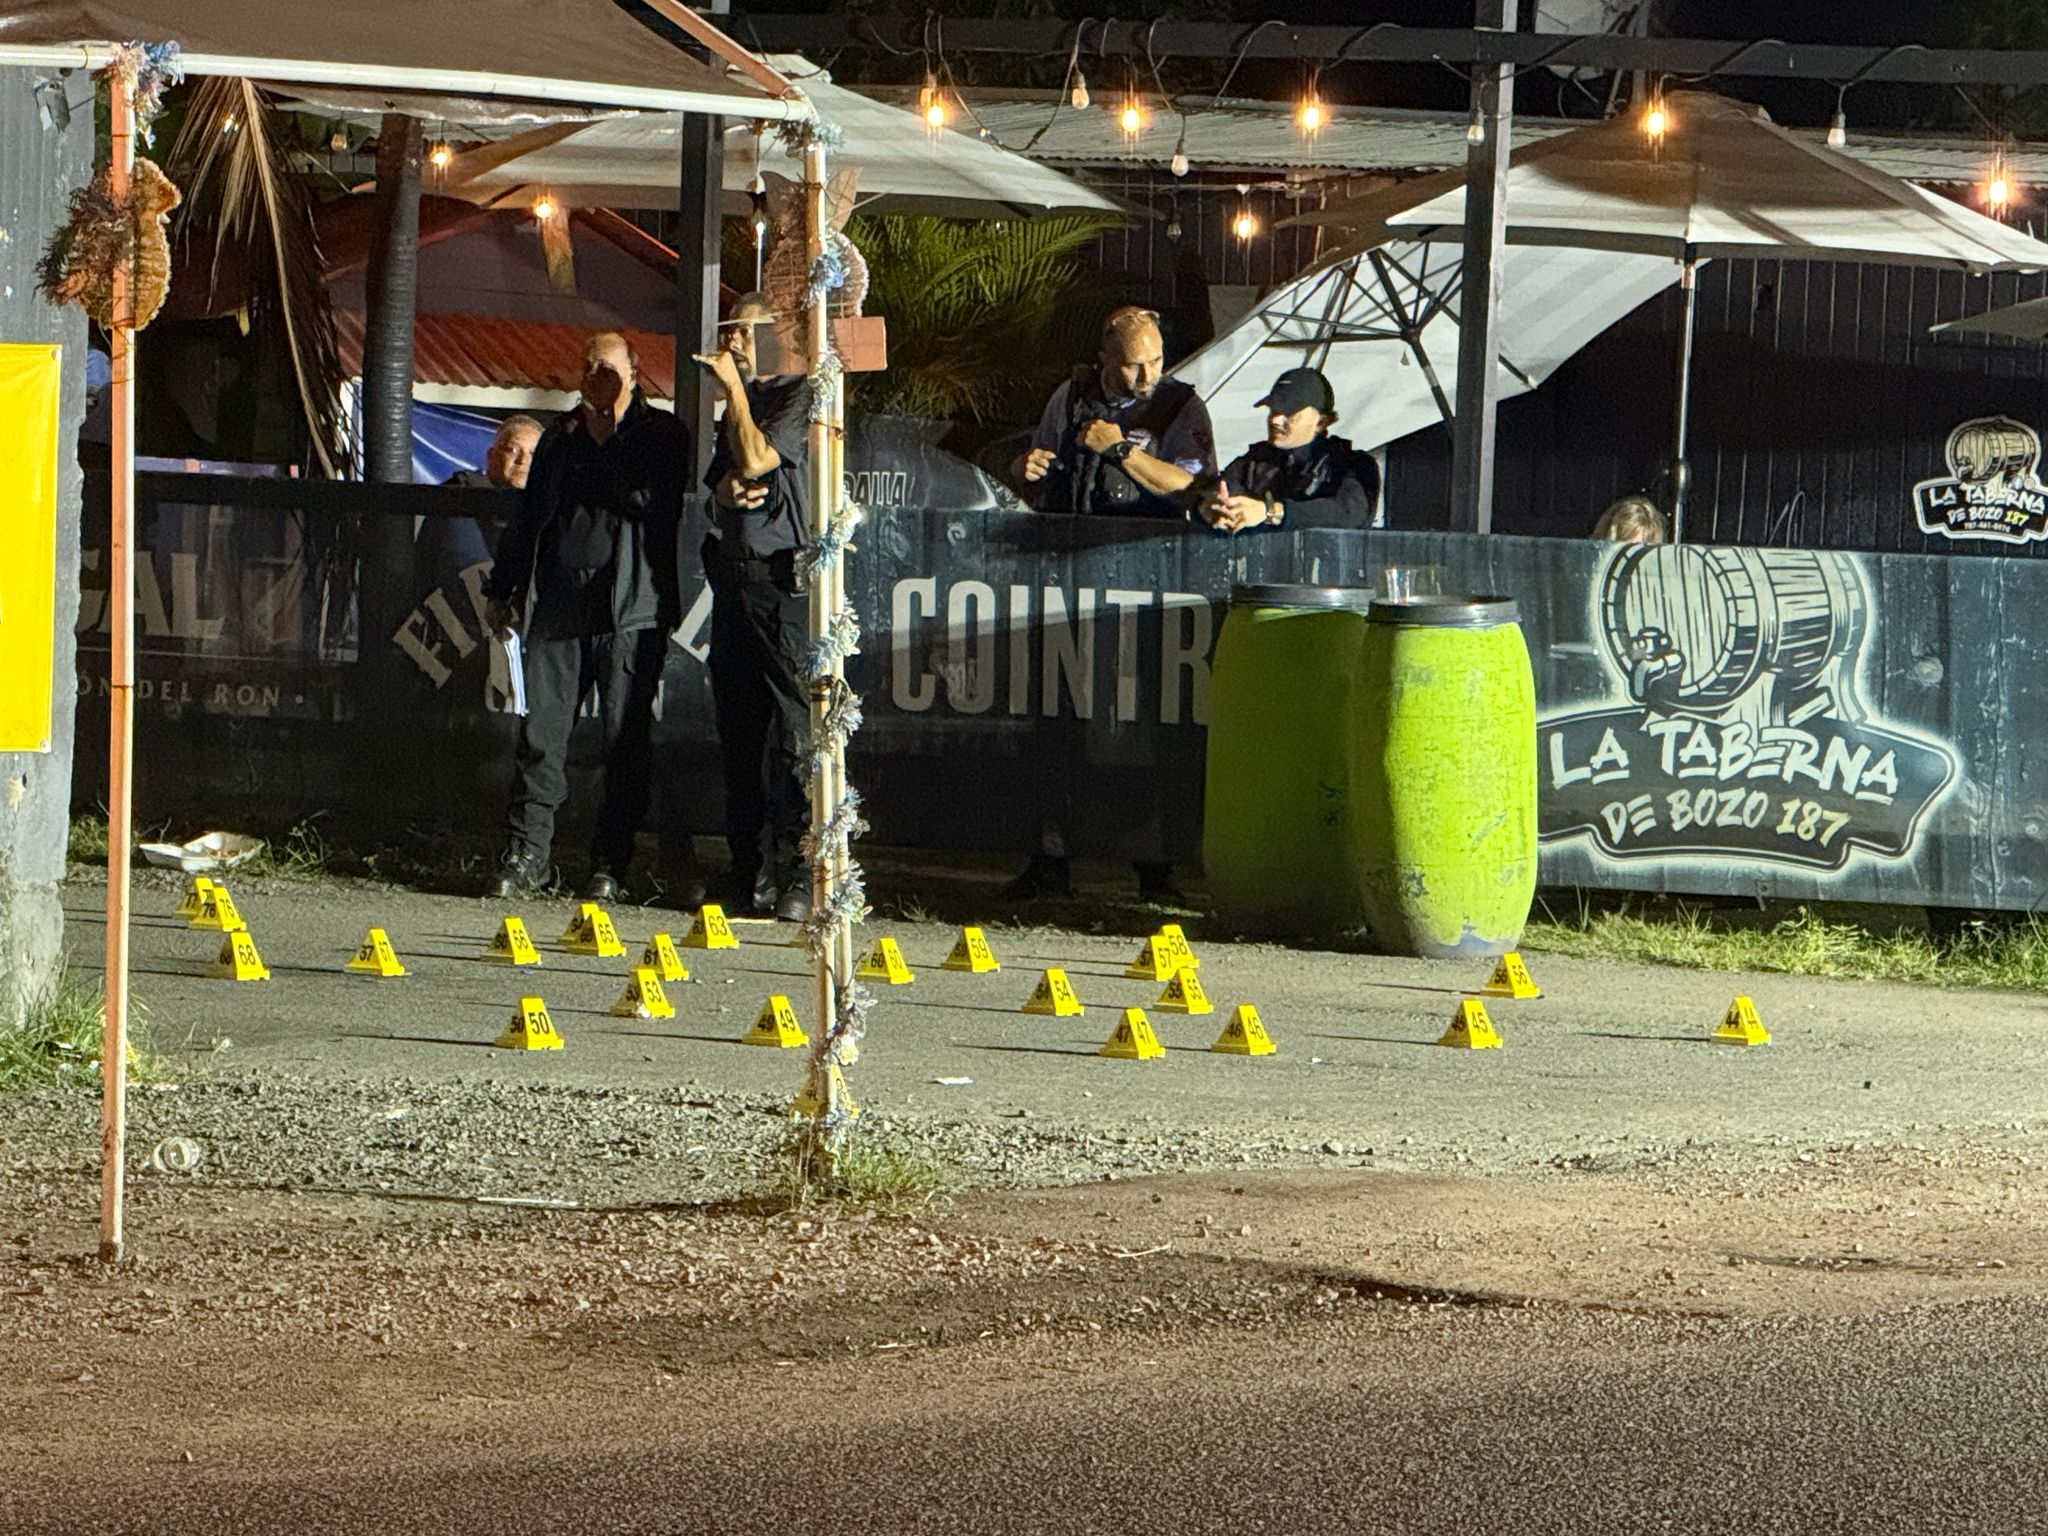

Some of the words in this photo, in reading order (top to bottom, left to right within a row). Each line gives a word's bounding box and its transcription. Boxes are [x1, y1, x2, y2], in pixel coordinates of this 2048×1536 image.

[1929, 486, 1957, 507] LA
[1959, 481, 2046, 515] TABERNA
[1946, 507, 1966, 525] DE
[1968, 505, 2004, 520] BOZO
[2003, 510, 2029, 527] 187
[892, 576, 1213, 726] COINTR
[137, 679, 192, 702] DEL
[213, 683, 279, 707] RON
[1550, 726, 1630, 790] LA
[1640, 712, 1900, 804] TABERNA
[1601, 794, 1660, 845] DE
[1667, 788, 1768, 832] BOZO
[1775, 800, 1850, 847] 187
[708, 915, 728, 937] 63
[238, 944, 256, 966] 68
[970, 938, 989, 959] 59
[1168, 935, 1188, 956] 58
[1158, 947, 1172, 969] 57
[1054, 979, 1071, 1002] 54
[528, 1011, 550, 1035] 50
[779, 1009, 796, 1033] 49
[1248, 1016, 1265, 1041] 46
[1472, 1012, 1488, 1034] 45
